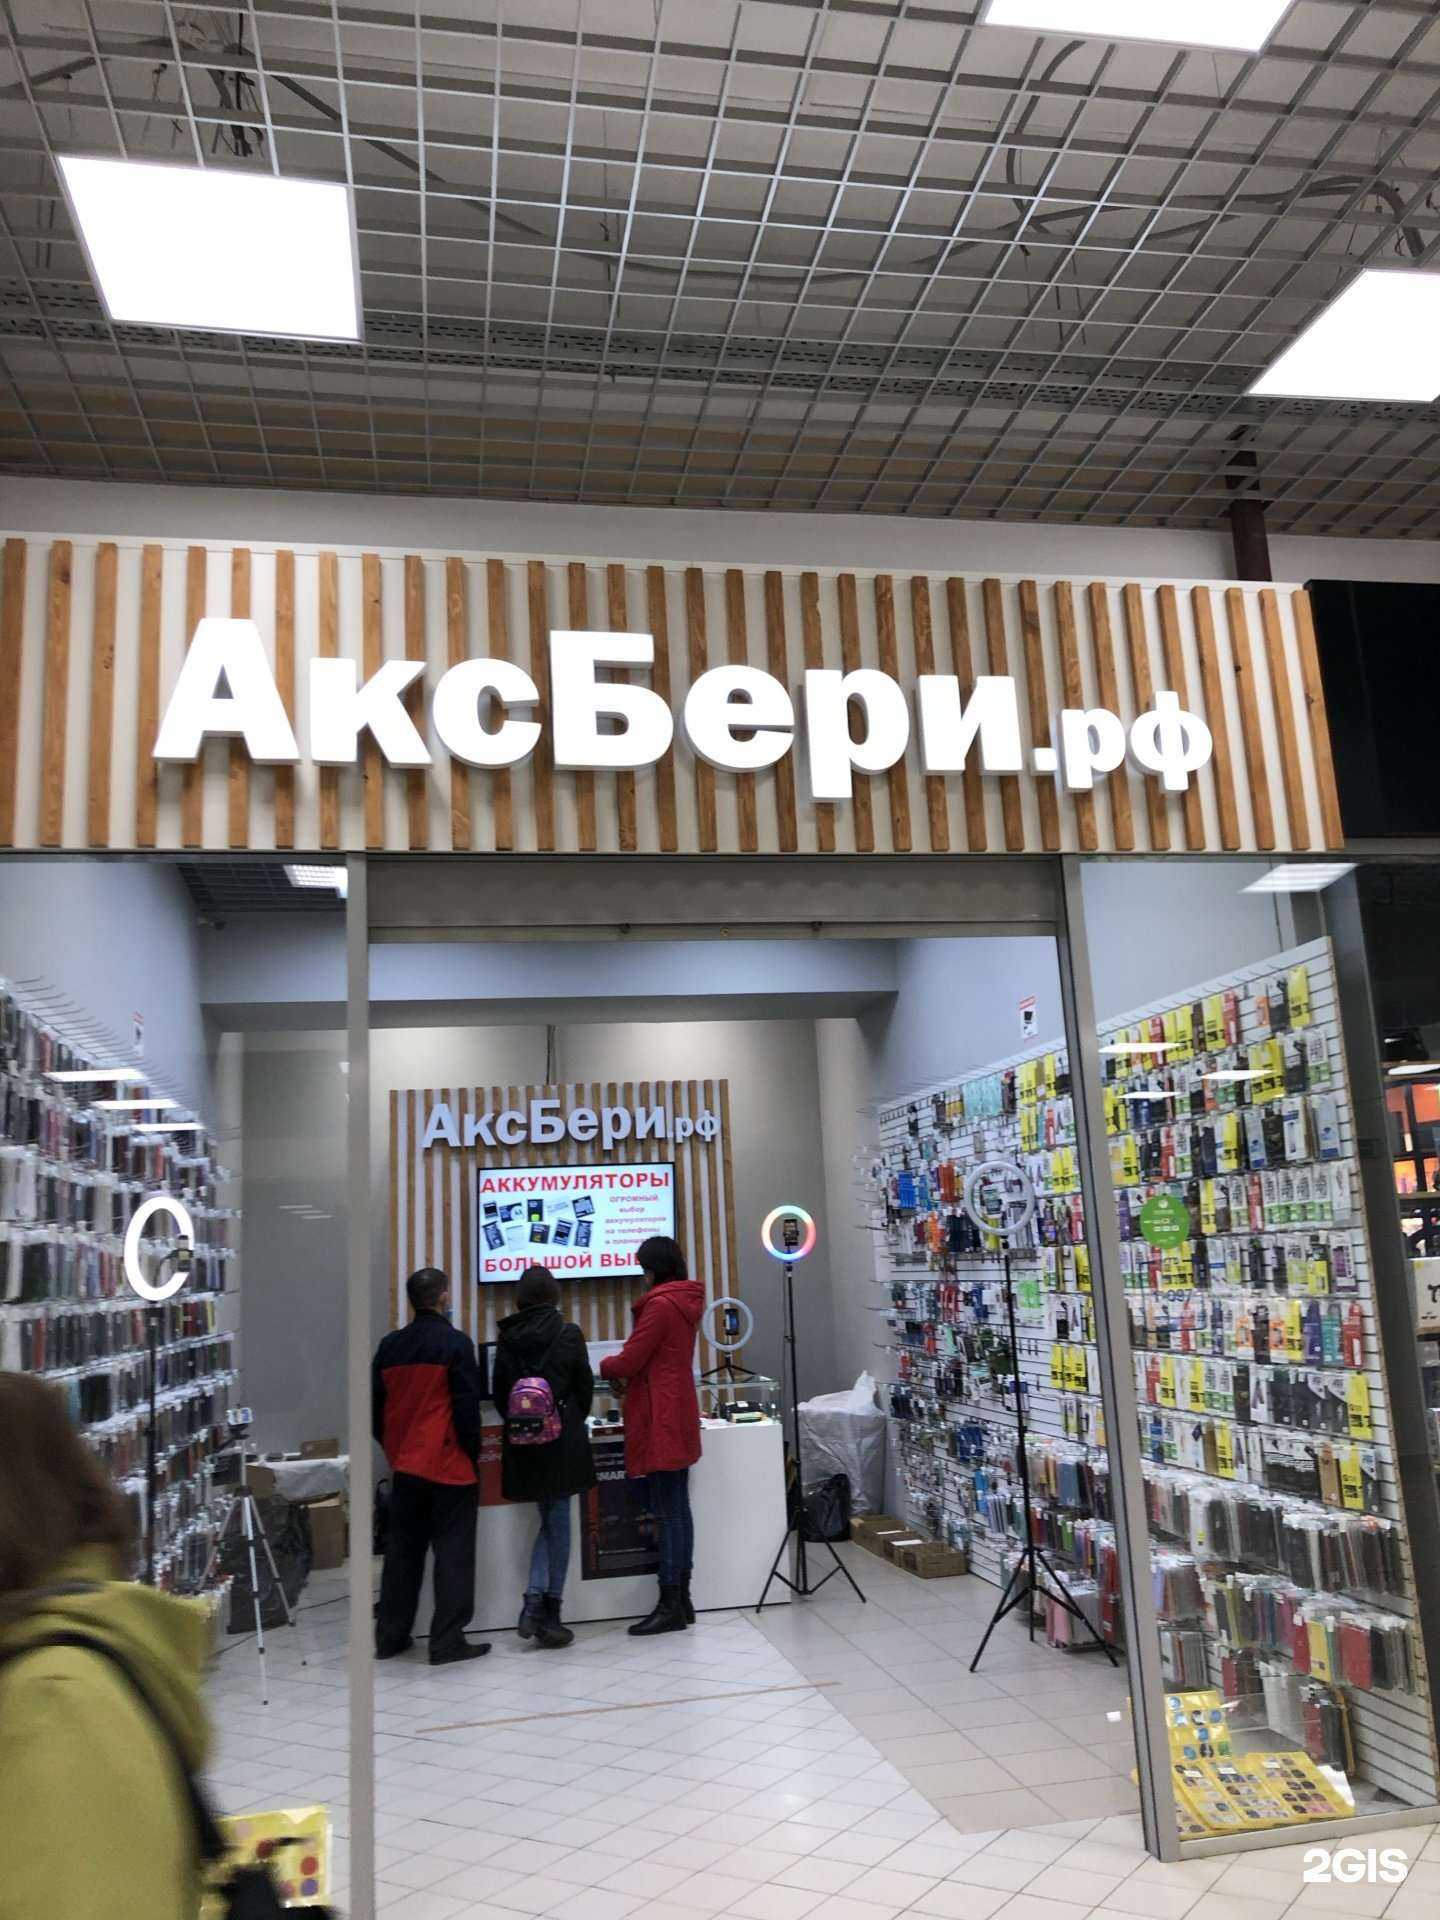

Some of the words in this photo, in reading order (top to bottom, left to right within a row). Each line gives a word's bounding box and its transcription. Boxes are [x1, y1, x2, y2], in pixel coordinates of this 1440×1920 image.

[153, 616, 1214, 802] АксБери.рф
[421, 1099, 721, 1150] АксБери.рф
[480, 1171, 670, 1193] АККУМУЛЯТОРЫ
